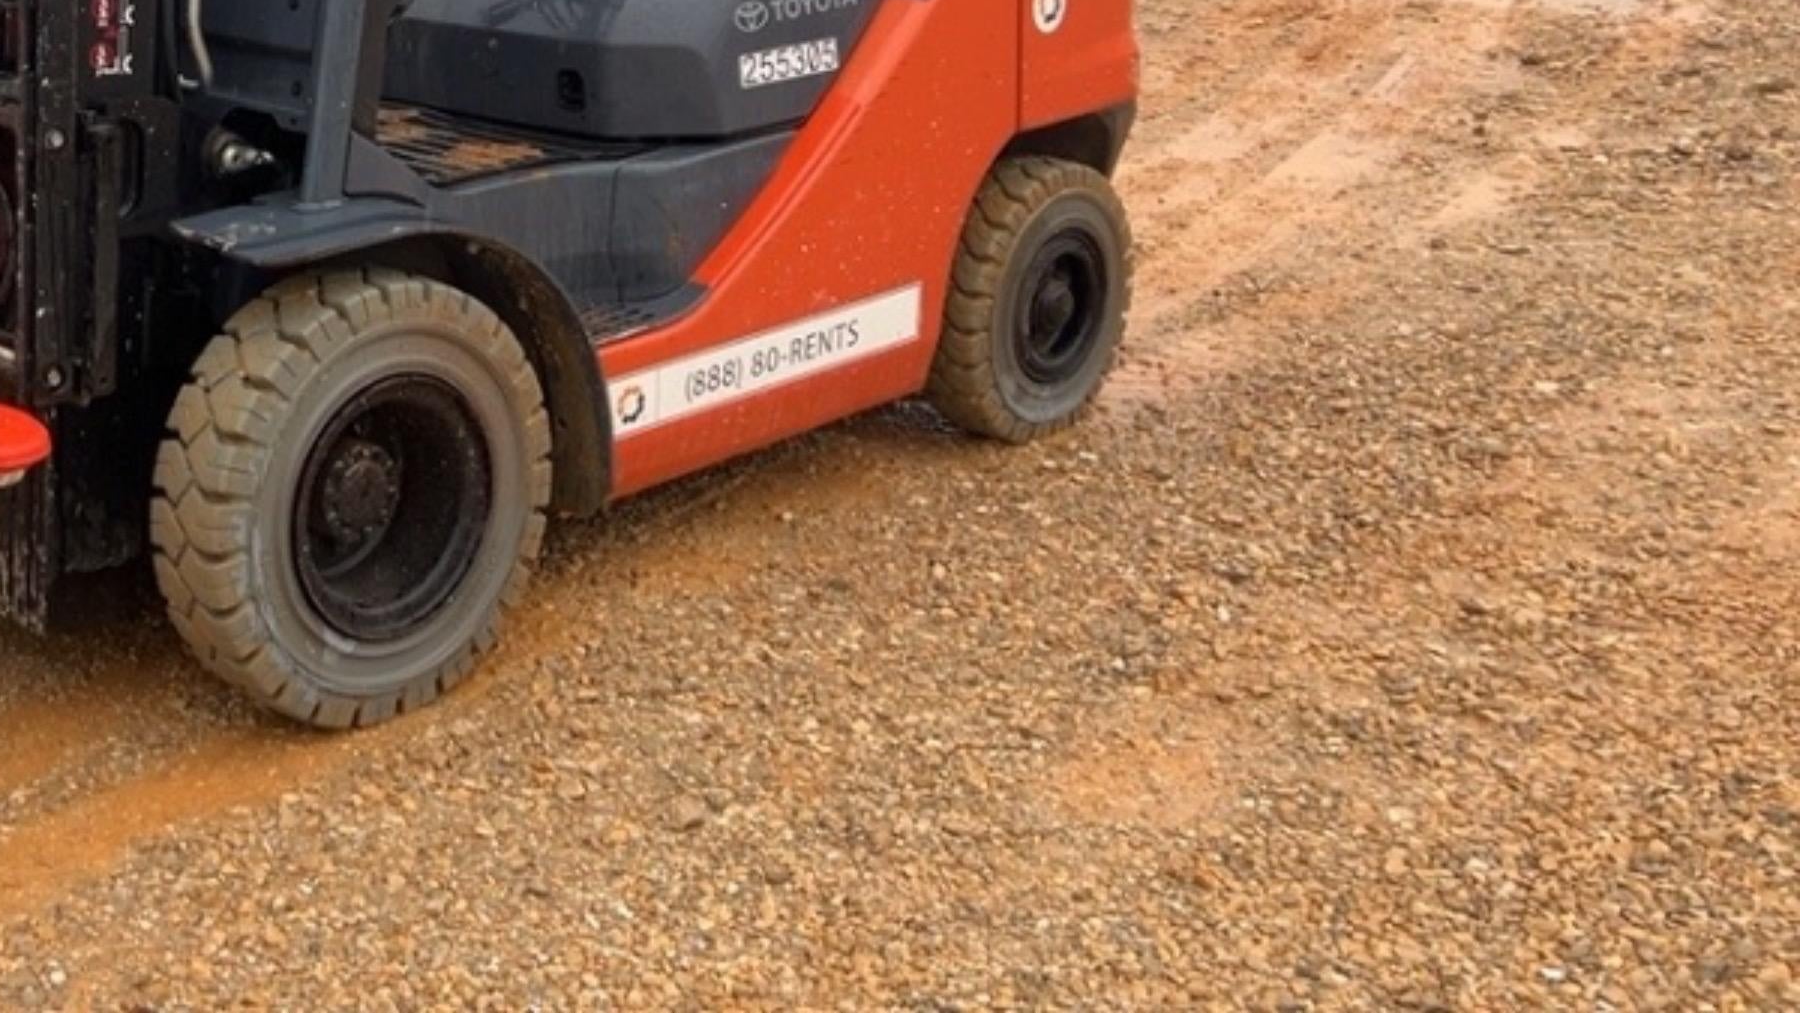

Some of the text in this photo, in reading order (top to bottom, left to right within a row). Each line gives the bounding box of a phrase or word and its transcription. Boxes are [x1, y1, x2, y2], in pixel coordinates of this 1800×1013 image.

[741, 38, 838, 86] 255305
[684, 319, 860, 402] (888) 80-RENTS
